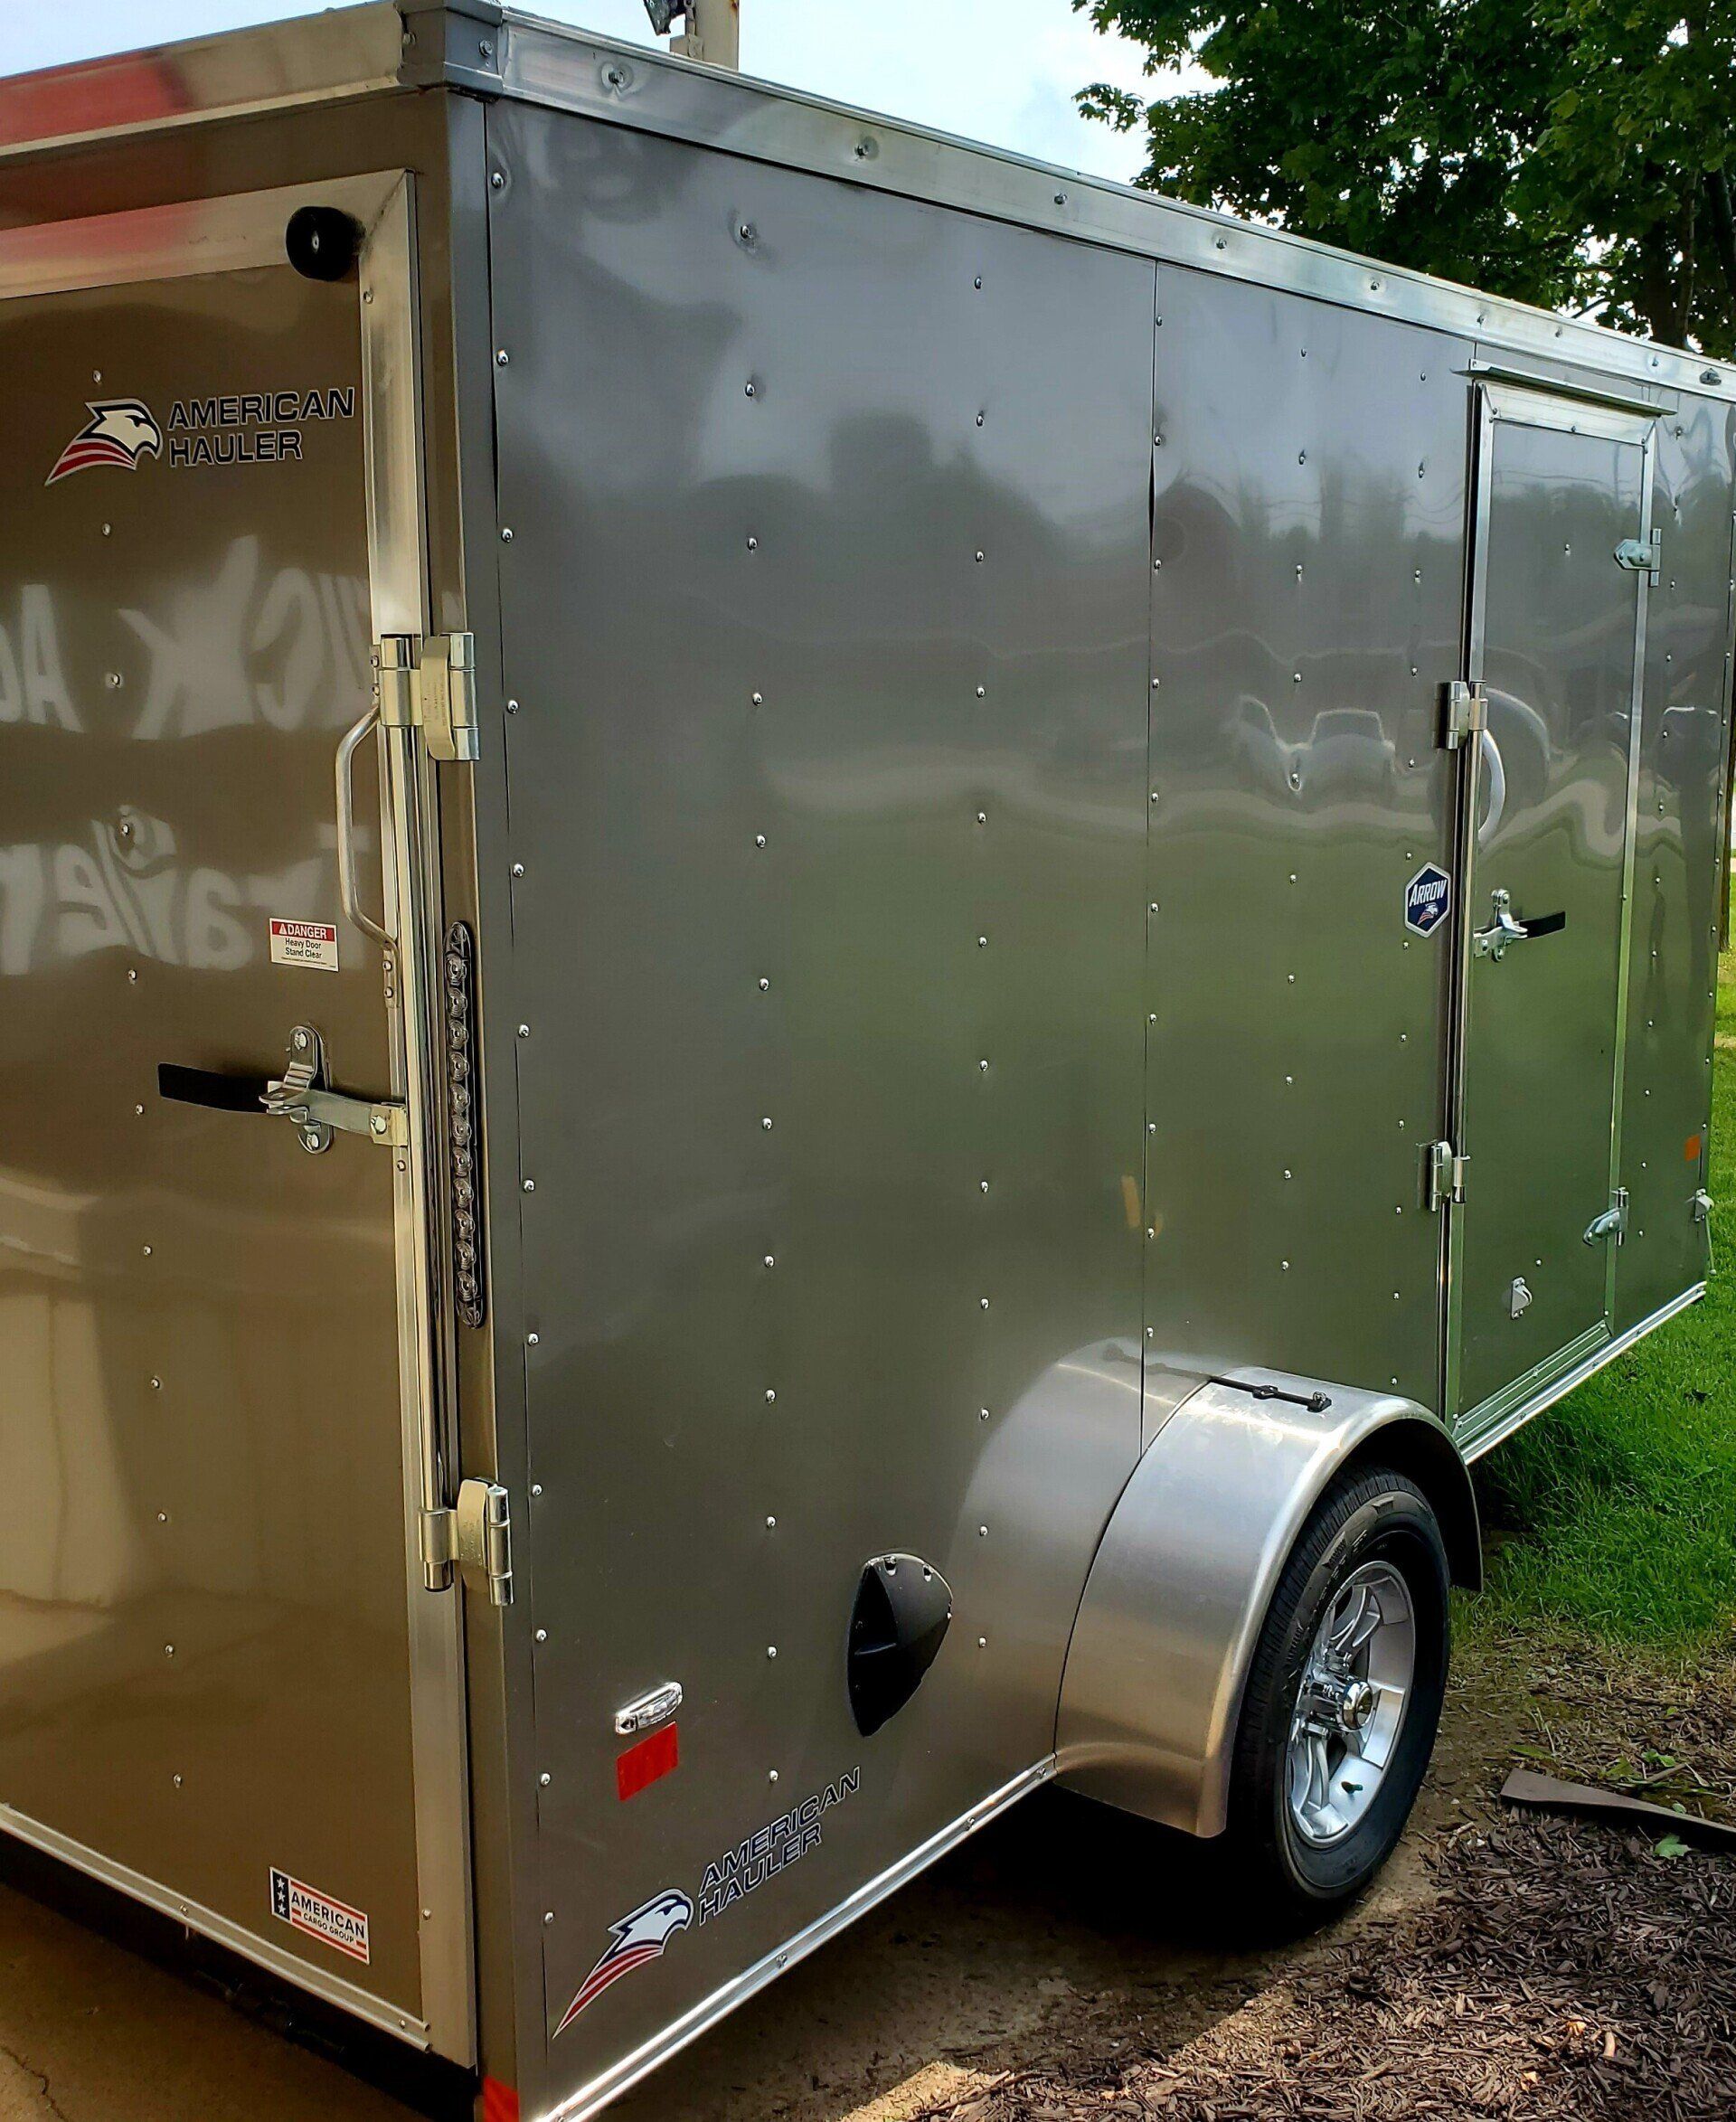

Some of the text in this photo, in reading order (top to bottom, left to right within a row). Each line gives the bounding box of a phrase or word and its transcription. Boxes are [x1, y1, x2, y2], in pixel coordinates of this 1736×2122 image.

[167, 386, 356, 431] AMERICAN
[169, 429, 303, 467] HAULER
[1409, 879, 1448, 908] ARROW
[285, 938, 322, 949] Heavy Door
[288, 924, 327, 939] DANGER
[285, 947, 322, 959] Stand Clear
[698, 1766, 861, 1897] AMERICAN
[699, 1822, 822, 1926] HAULER
[291, 1891, 365, 1938] AMERICAN
[303, 1912, 354, 1943] CARGO GROUP
